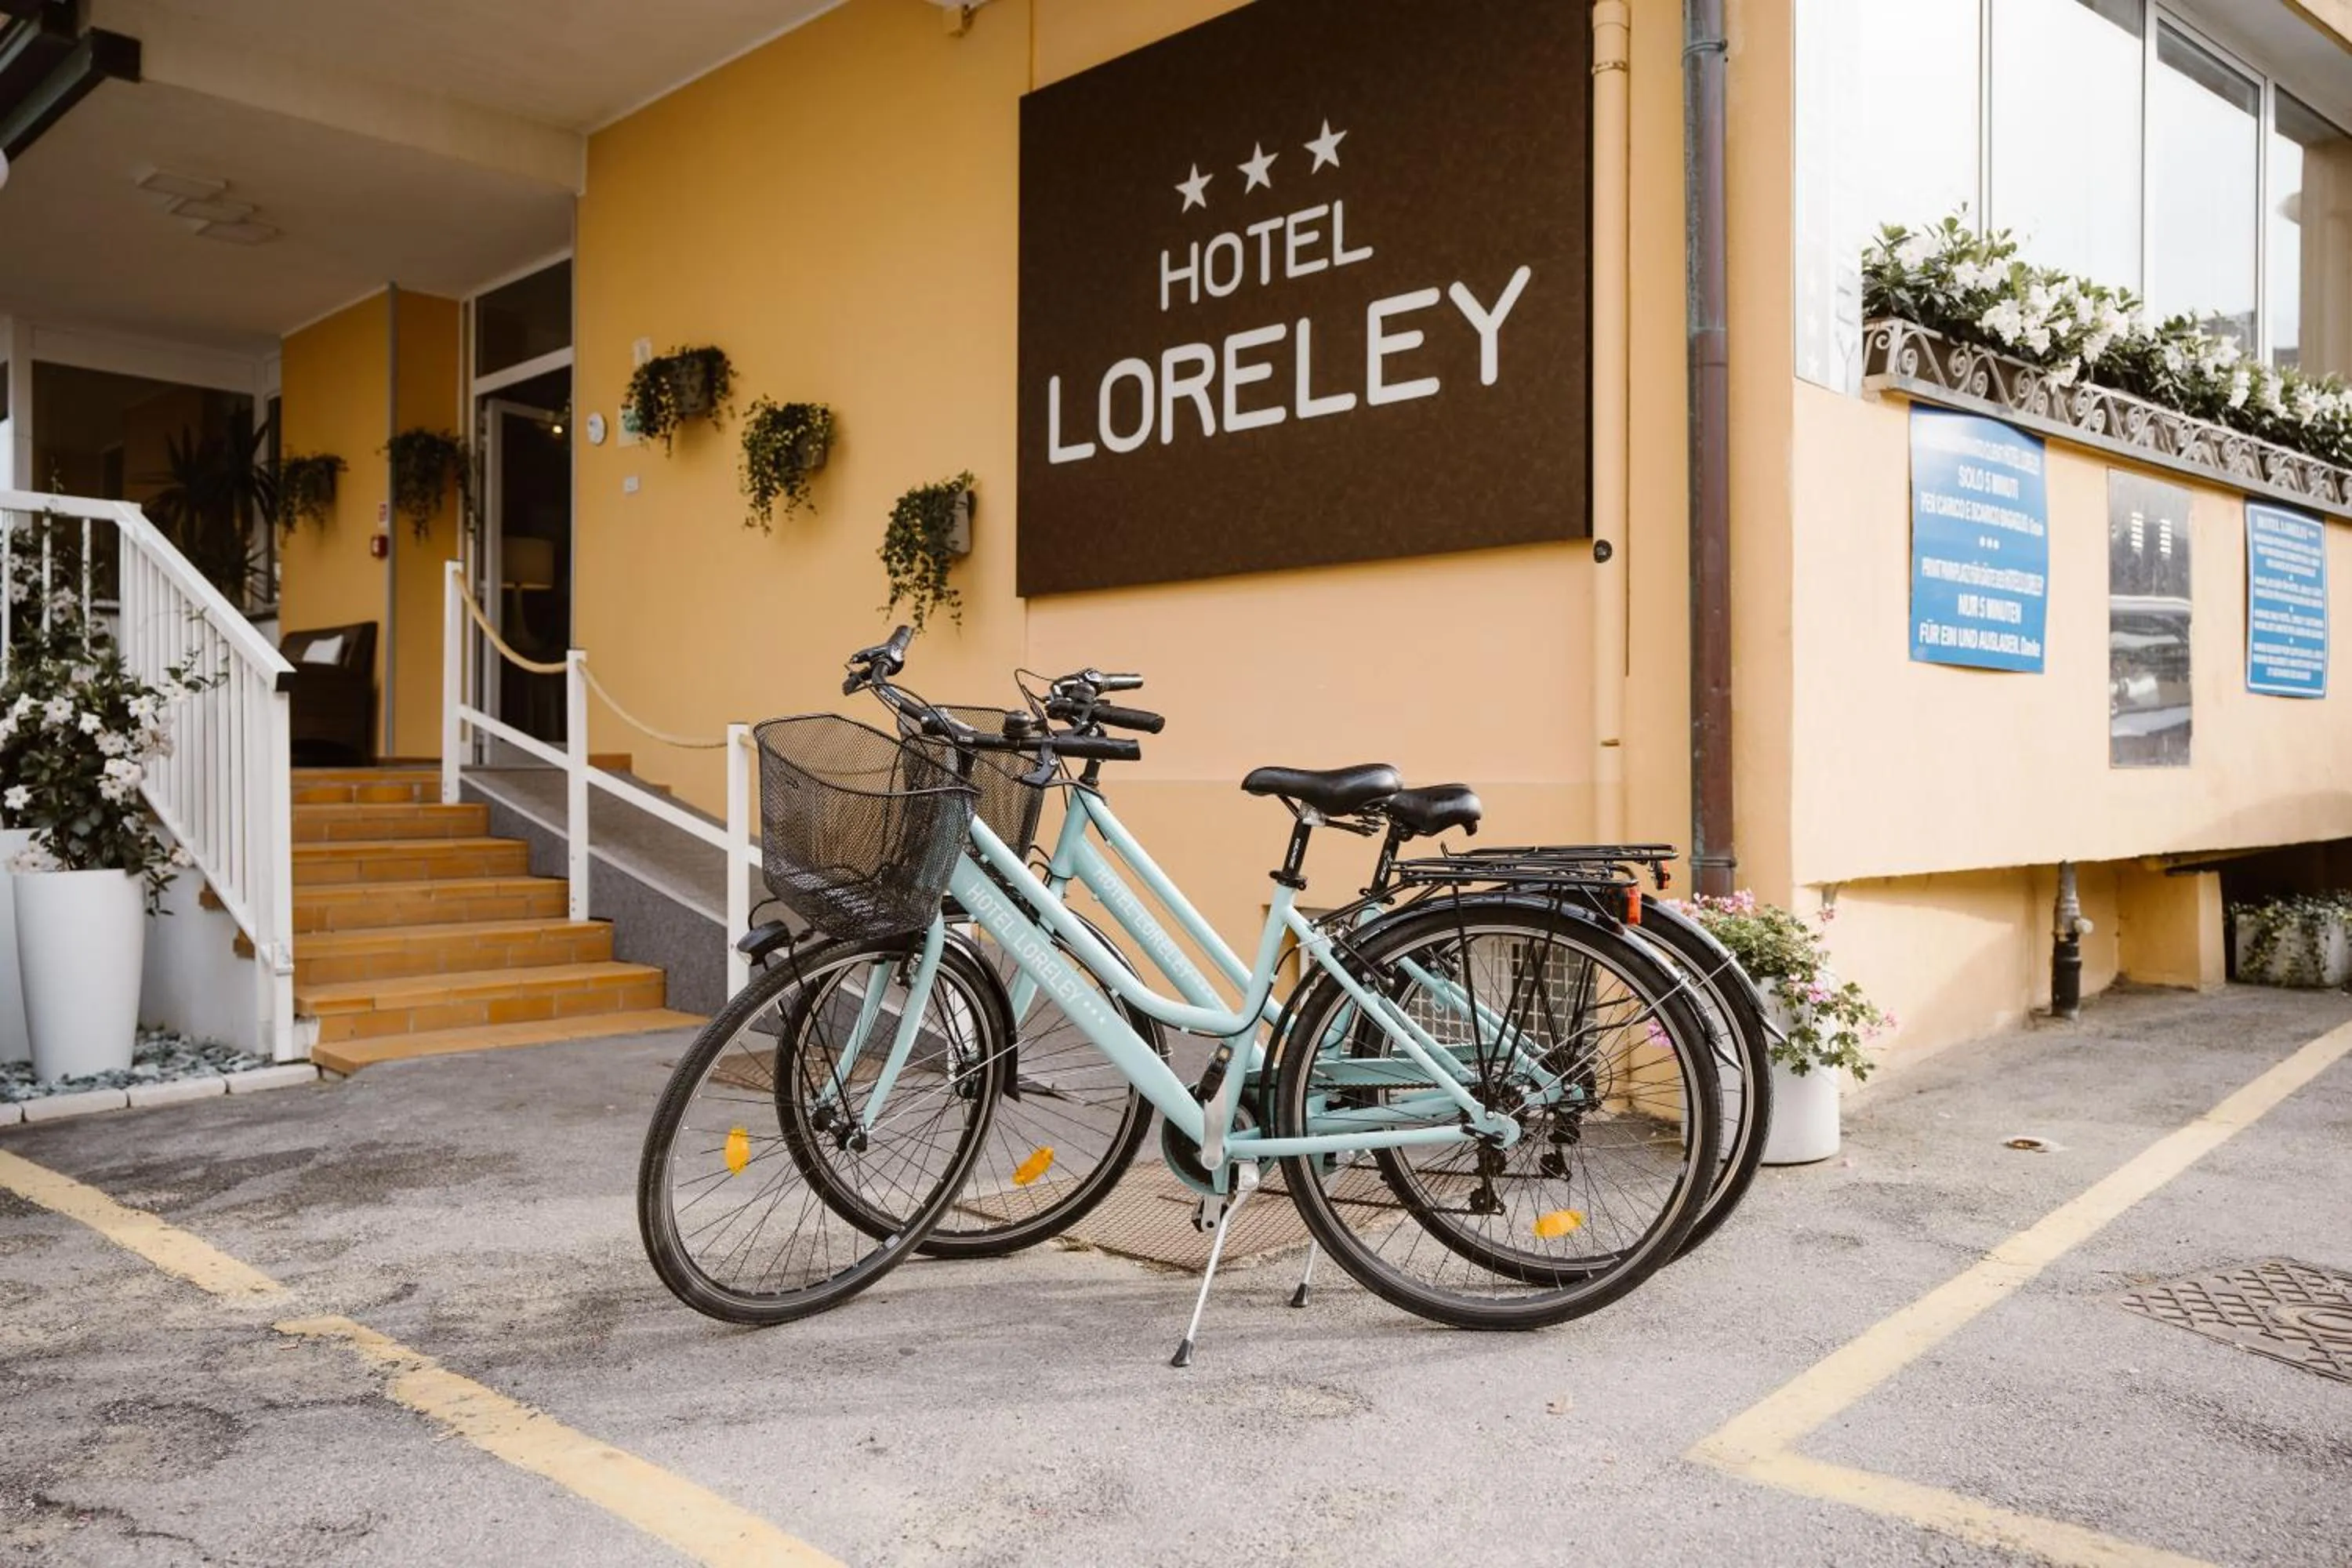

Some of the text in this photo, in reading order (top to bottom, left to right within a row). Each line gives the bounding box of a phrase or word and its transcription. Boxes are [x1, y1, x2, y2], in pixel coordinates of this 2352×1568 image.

[1160, 200, 1373, 311] HOTEL
[1048, 265, 1531, 463] LORELEY
[965, 882, 1083, 1004] HOTEL LORELEY
